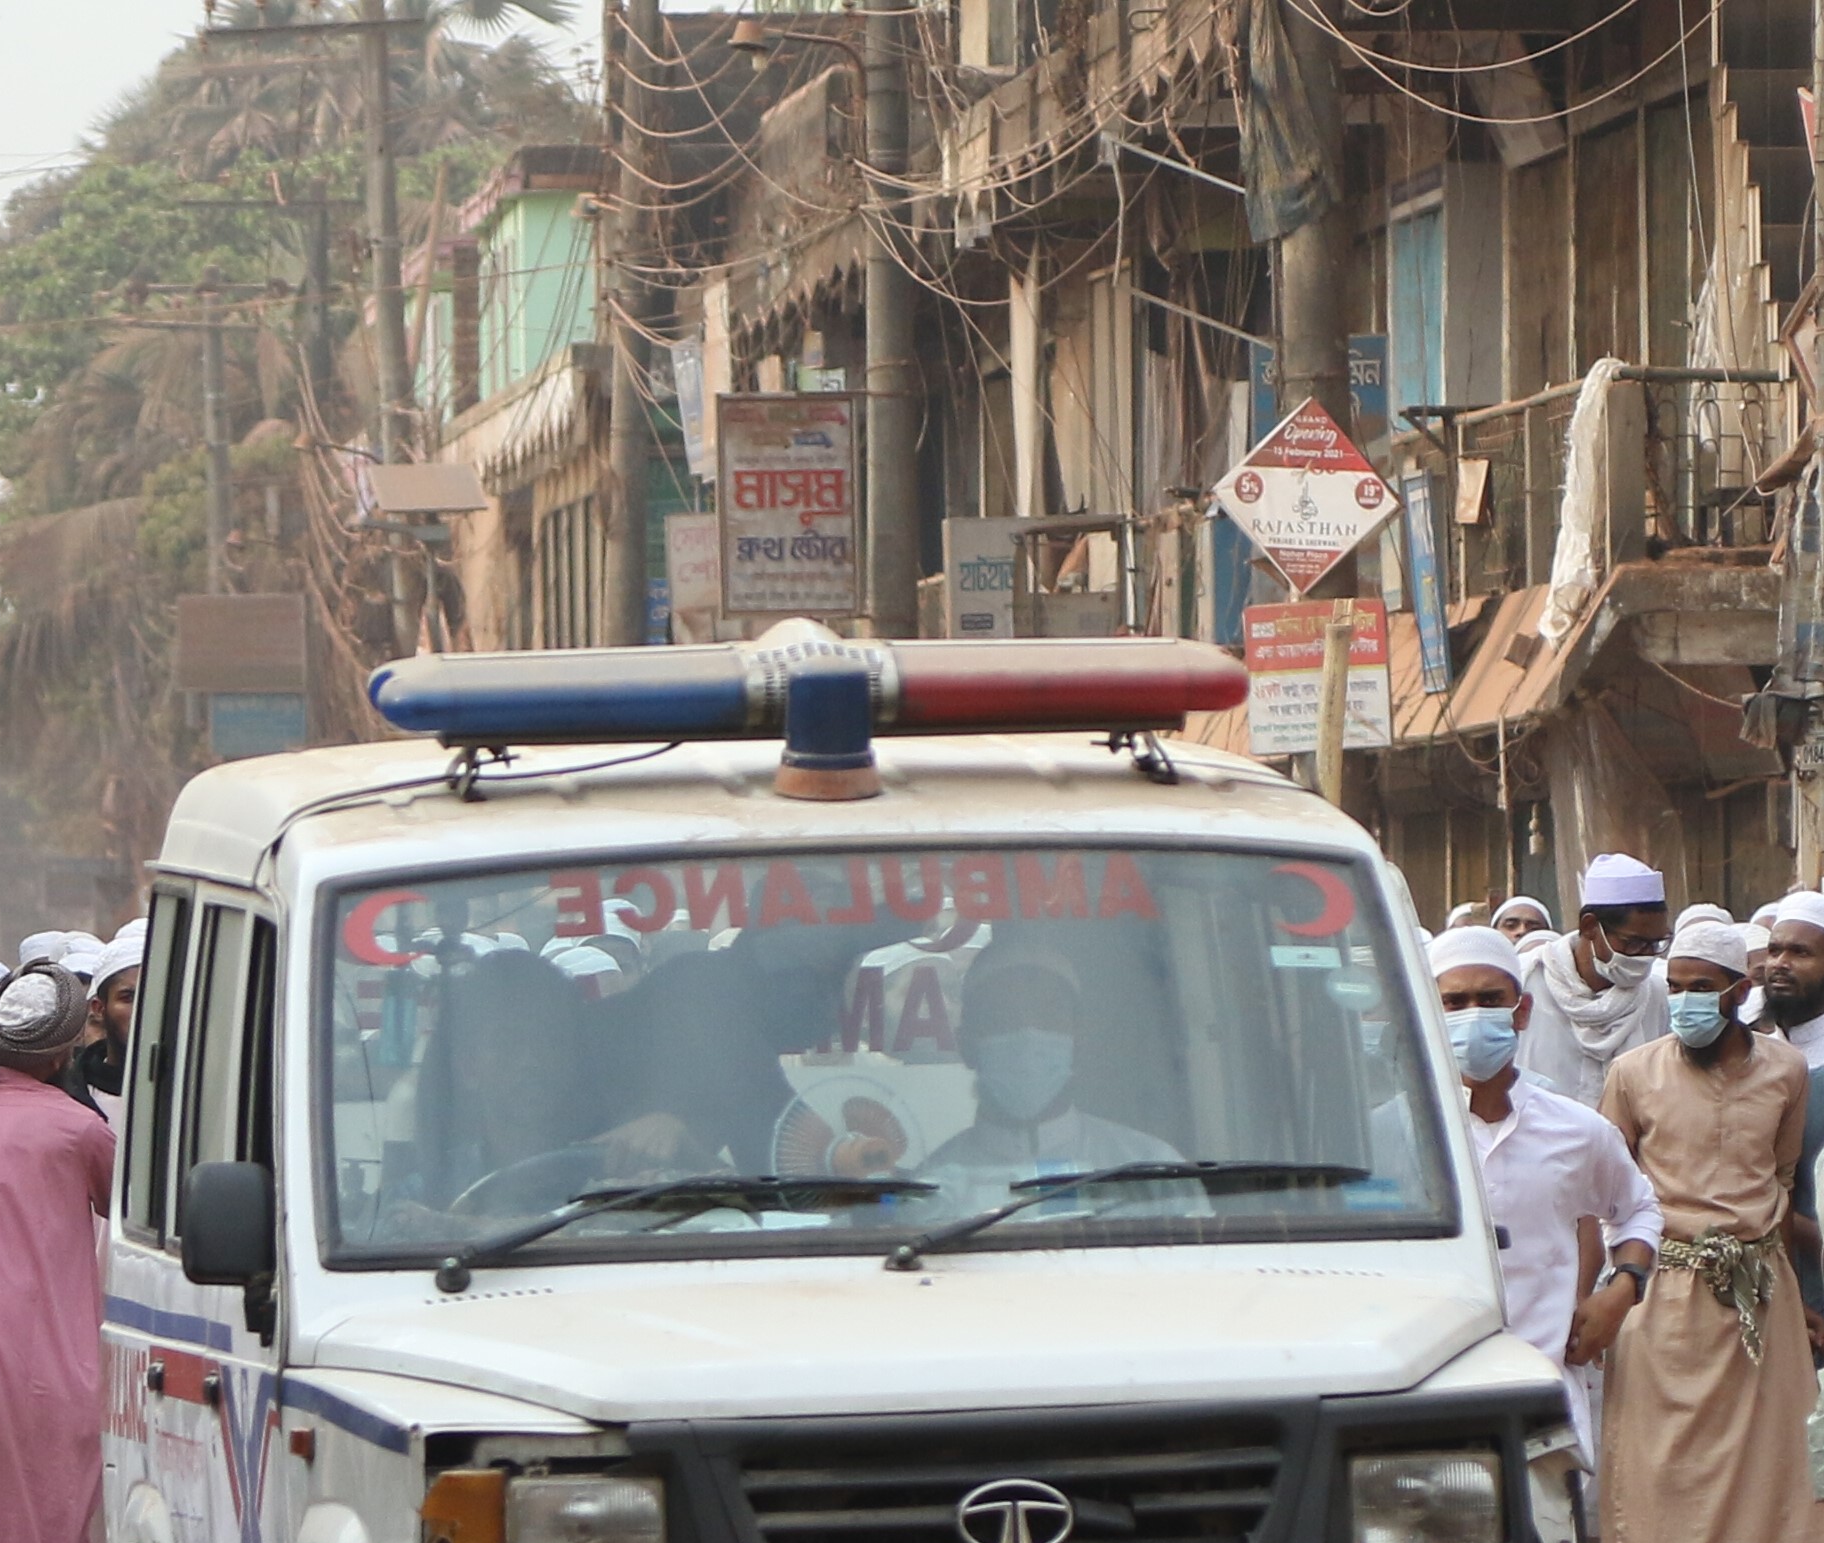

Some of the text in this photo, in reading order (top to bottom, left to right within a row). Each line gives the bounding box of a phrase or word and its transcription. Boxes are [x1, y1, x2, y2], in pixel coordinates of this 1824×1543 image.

[1284, 423, 1338, 447] Opening
[1241, 481, 1259, 500] 5%
[1251, 518, 1358, 537] RAJASTHAN
